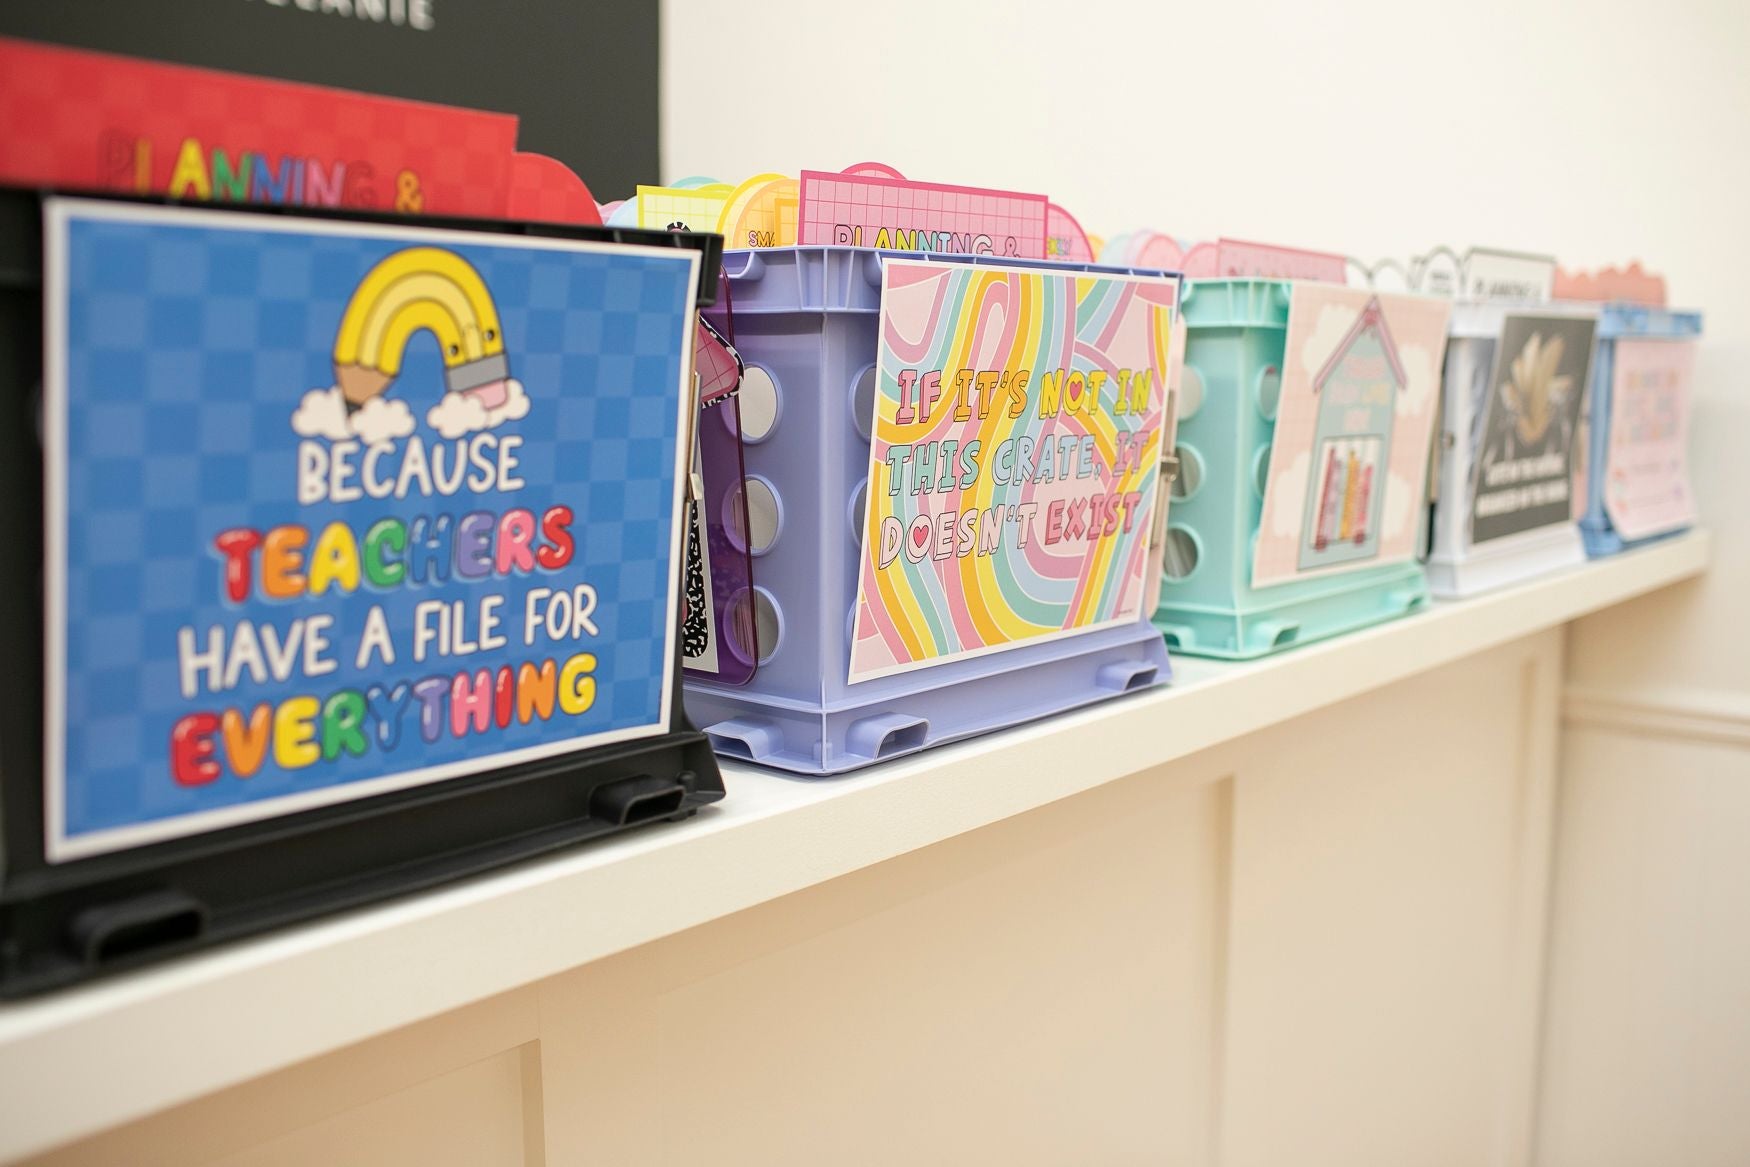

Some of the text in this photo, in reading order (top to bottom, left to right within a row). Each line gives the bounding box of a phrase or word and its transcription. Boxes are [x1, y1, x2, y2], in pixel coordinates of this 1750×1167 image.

[395, 169, 424, 214] &
[895, 367, 1154, 425] IF IT'S NOT IN
[298, 434, 525, 505] BECAUSE
[886, 430, 1151, 497] THIS CRATE, IT
[214, 505, 575, 603] TEACHERS
[878, 491, 1143, 571] DOESN'T EXIST
[178, 583, 599, 698] HAVE A FILE FOR
[169, 652, 599, 788] EVERYTHING
